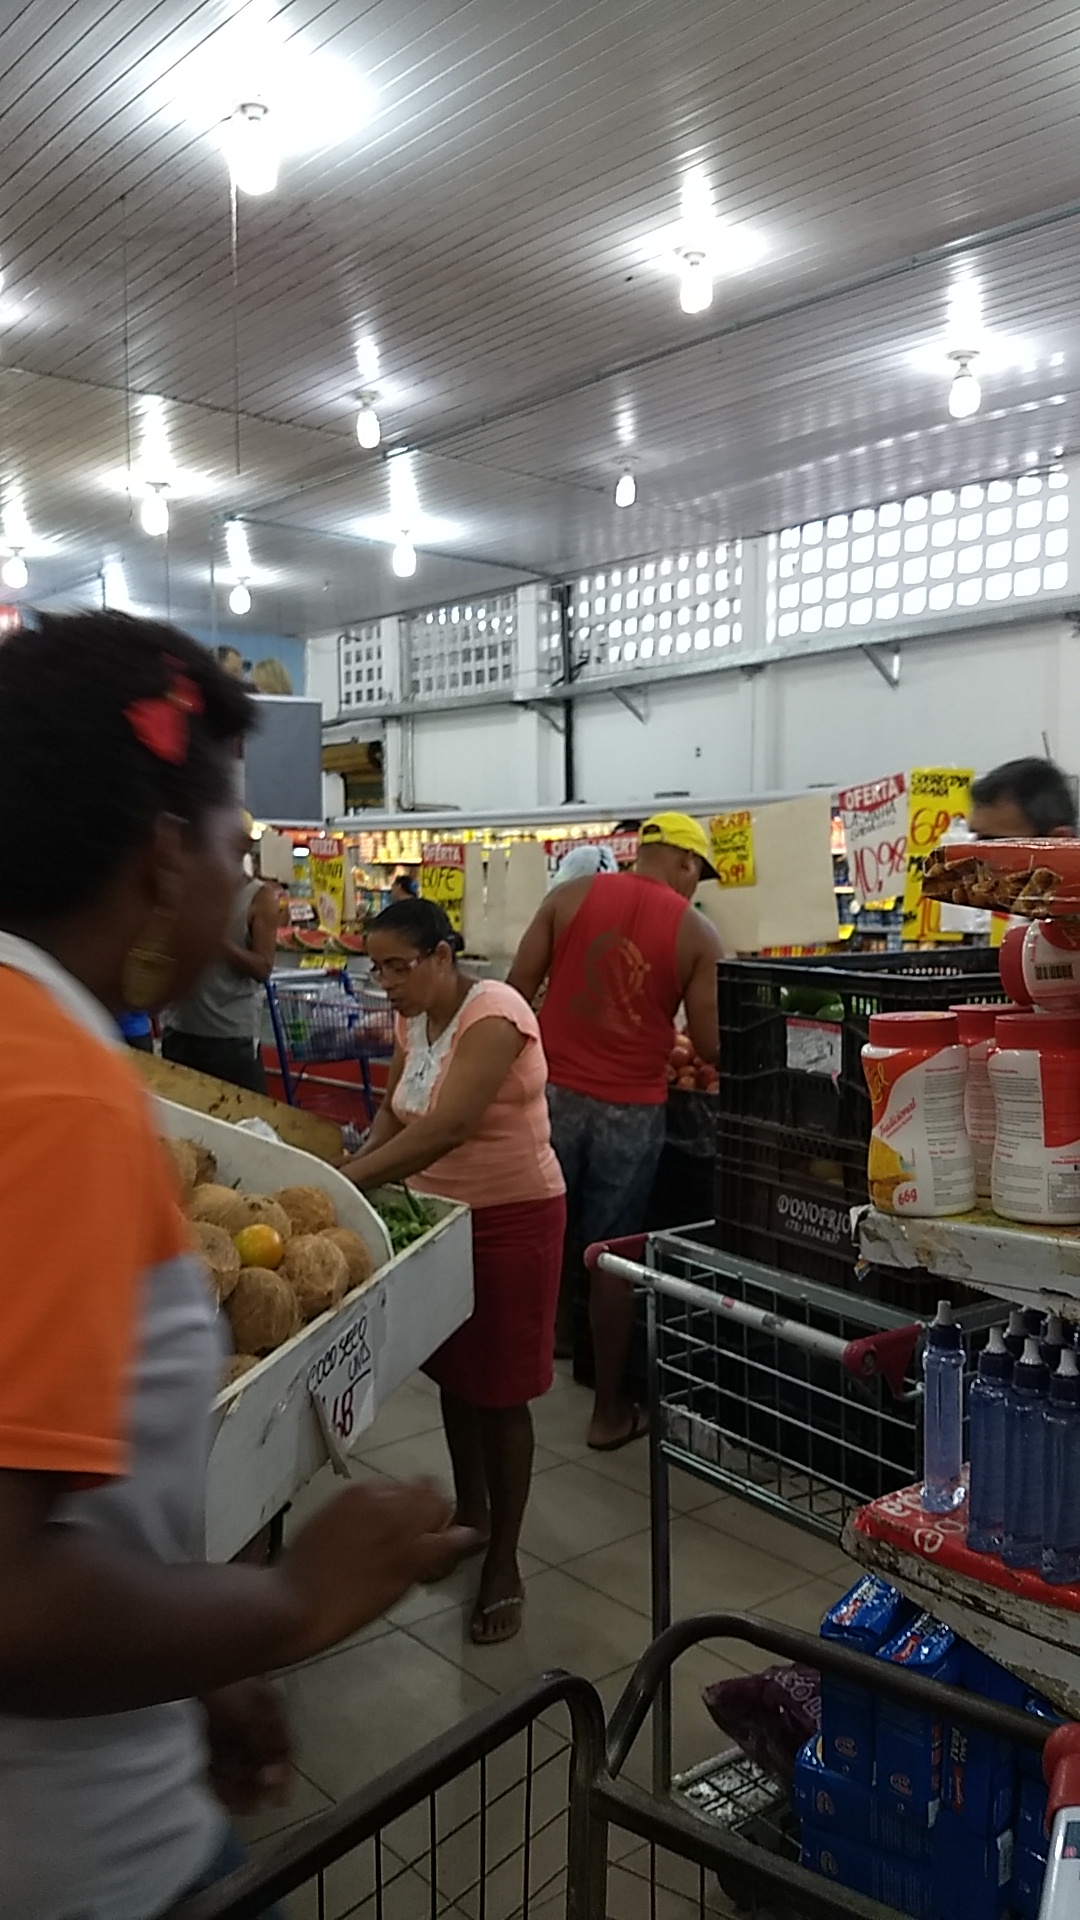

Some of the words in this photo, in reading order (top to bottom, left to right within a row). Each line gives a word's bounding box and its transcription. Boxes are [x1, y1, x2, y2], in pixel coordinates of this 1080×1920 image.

[846, 778, 898, 809] OFERTA
[423, 844, 461, 862] OFERTA
[898, 1188, 917, 1206] 66g
